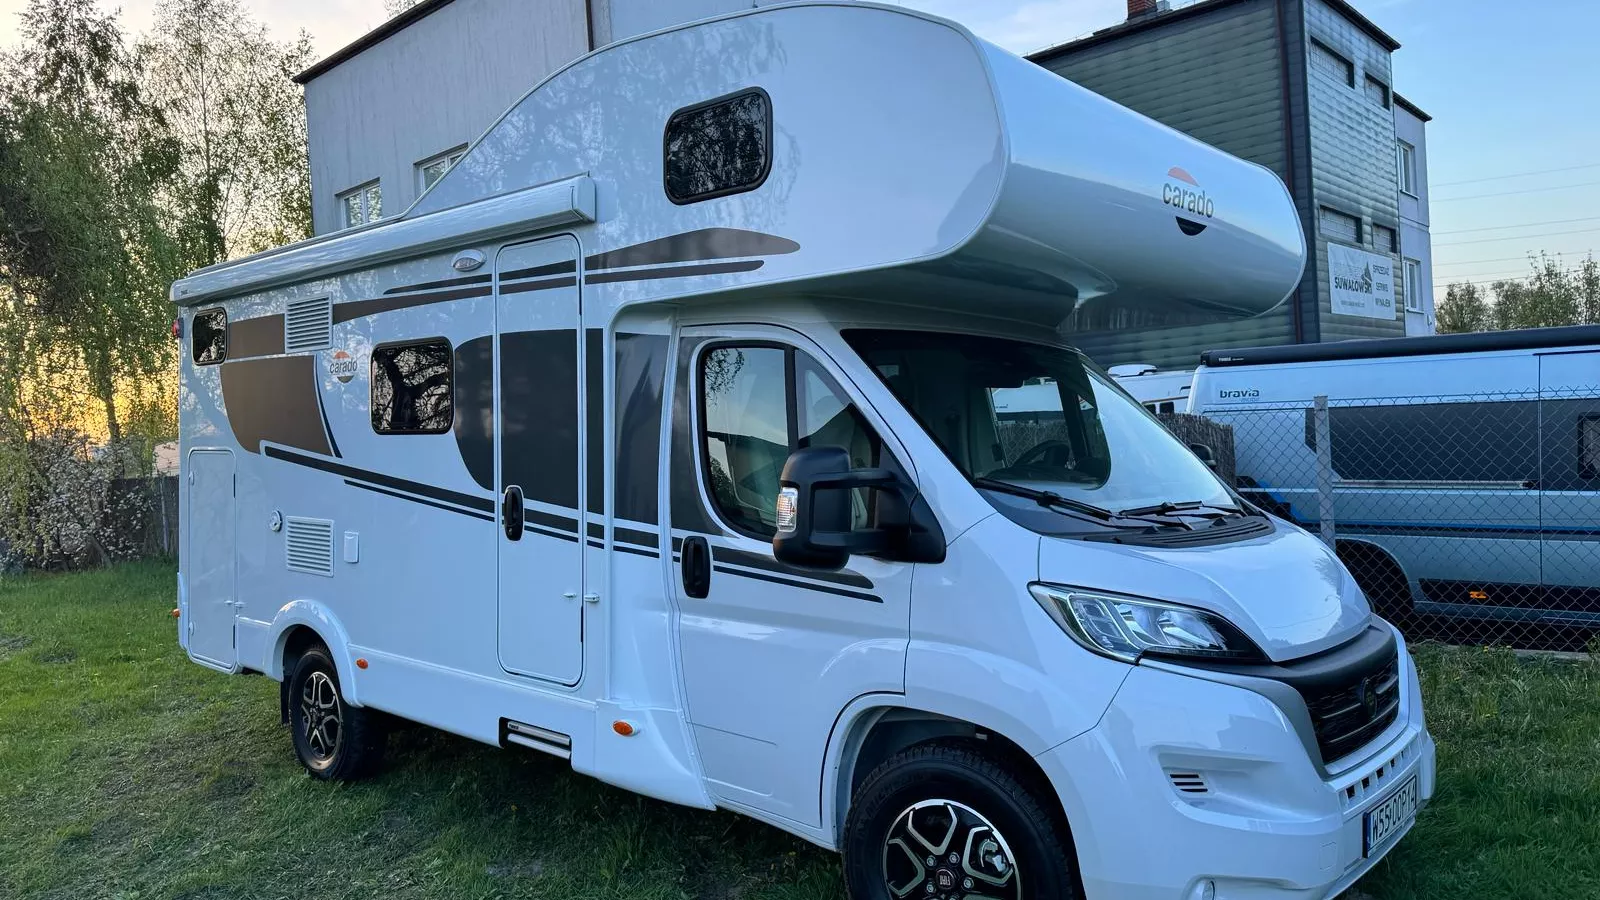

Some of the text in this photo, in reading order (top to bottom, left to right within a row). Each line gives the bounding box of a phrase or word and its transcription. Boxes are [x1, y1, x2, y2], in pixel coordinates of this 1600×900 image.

[1163, 183, 1214, 218] carado
[329, 358, 358, 374] carado
[1219, 388, 1260, 399] bravia
